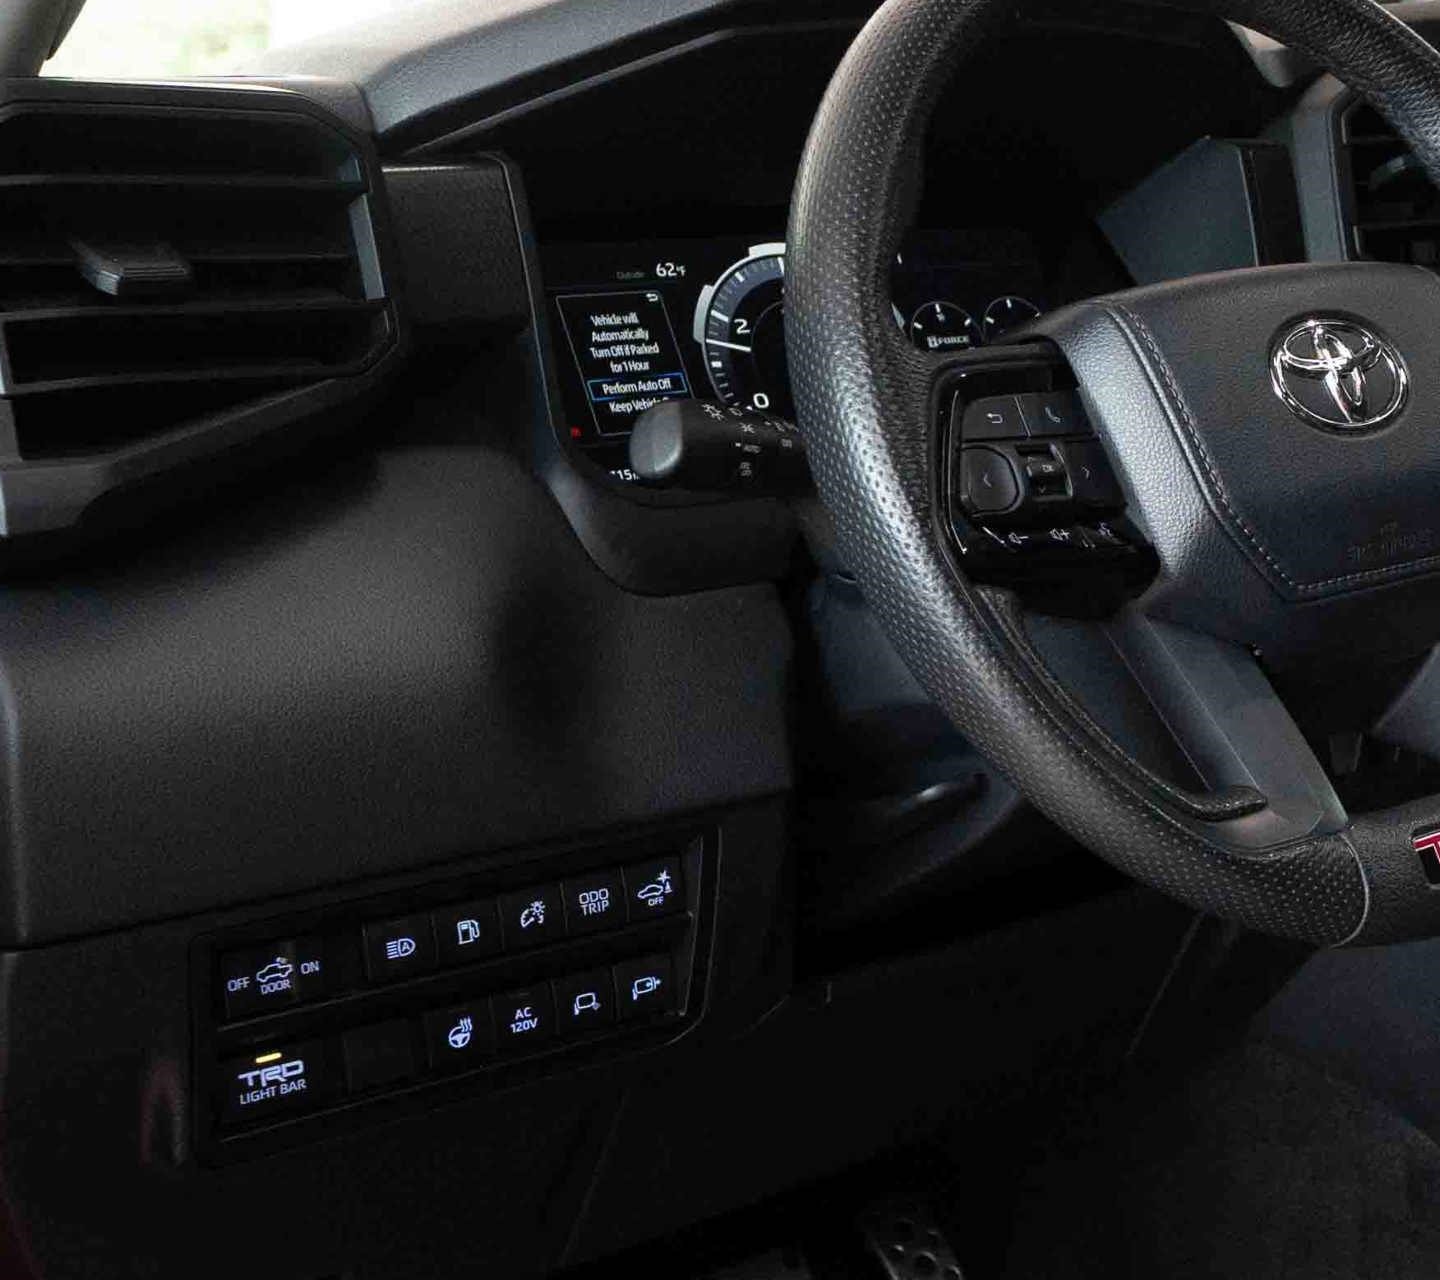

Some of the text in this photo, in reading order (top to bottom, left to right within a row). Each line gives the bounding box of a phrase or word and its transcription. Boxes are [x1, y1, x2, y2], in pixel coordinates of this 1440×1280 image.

[591, 311, 639, 326] Vehicle will
[734, 318, 751, 335] 2
[592, 327, 649, 342] Automatically
[590, 346, 610, 359] Turn
[610, 345, 624, 358] Off
[630, 342, 660, 356] Parked
[610, 361, 622, 373] for
[629, 360, 649, 371] Hour
[602, 378, 672, 395] Perform Auto Off
[610, 400, 632, 414] Keep
[753, 392, 769, 410] 0
[578, 887, 610, 906] ODO
[647, 895, 666, 908] OFF
[580, 898, 610, 917] TRIP
[300, 960, 320, 975] ON
[227, 976, 250, 992] OFF
[260, 978, 291, 995] DOOR
[514, 1006, 534, 1020] AC
[509, 1017, 538, 1034] 120V
[237, 1059, 305, 1087] TRD
[239, 1077, 308, 1106] LIGHT BAR
